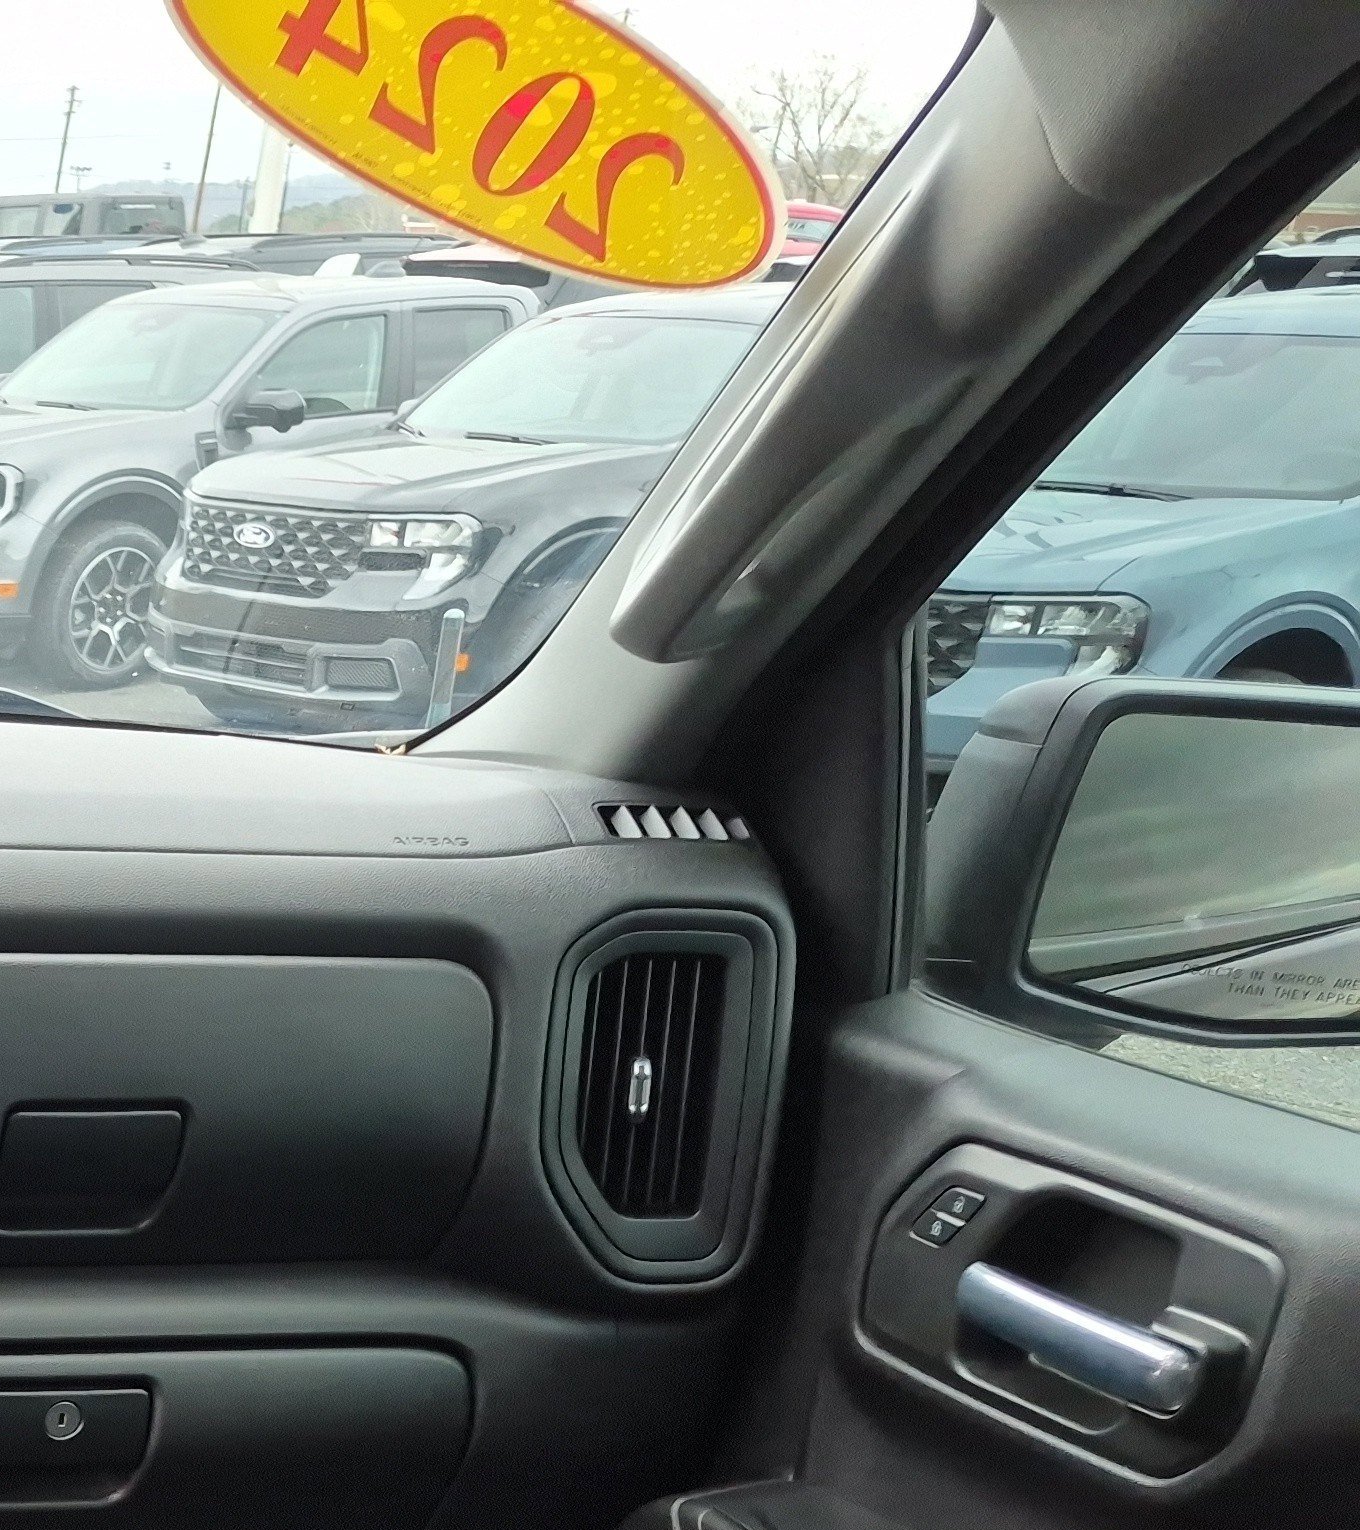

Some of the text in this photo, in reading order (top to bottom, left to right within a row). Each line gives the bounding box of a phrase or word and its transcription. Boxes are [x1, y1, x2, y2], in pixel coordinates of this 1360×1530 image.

[392, 836, 470, 847] AIRBAG
[1250, 970, 1264, 981] IN
[1272, 970, 1325, 986] MIRROR
[1229, 982, 1265, 997] THAN
[1274, 986, 1311, 1001] THEY
